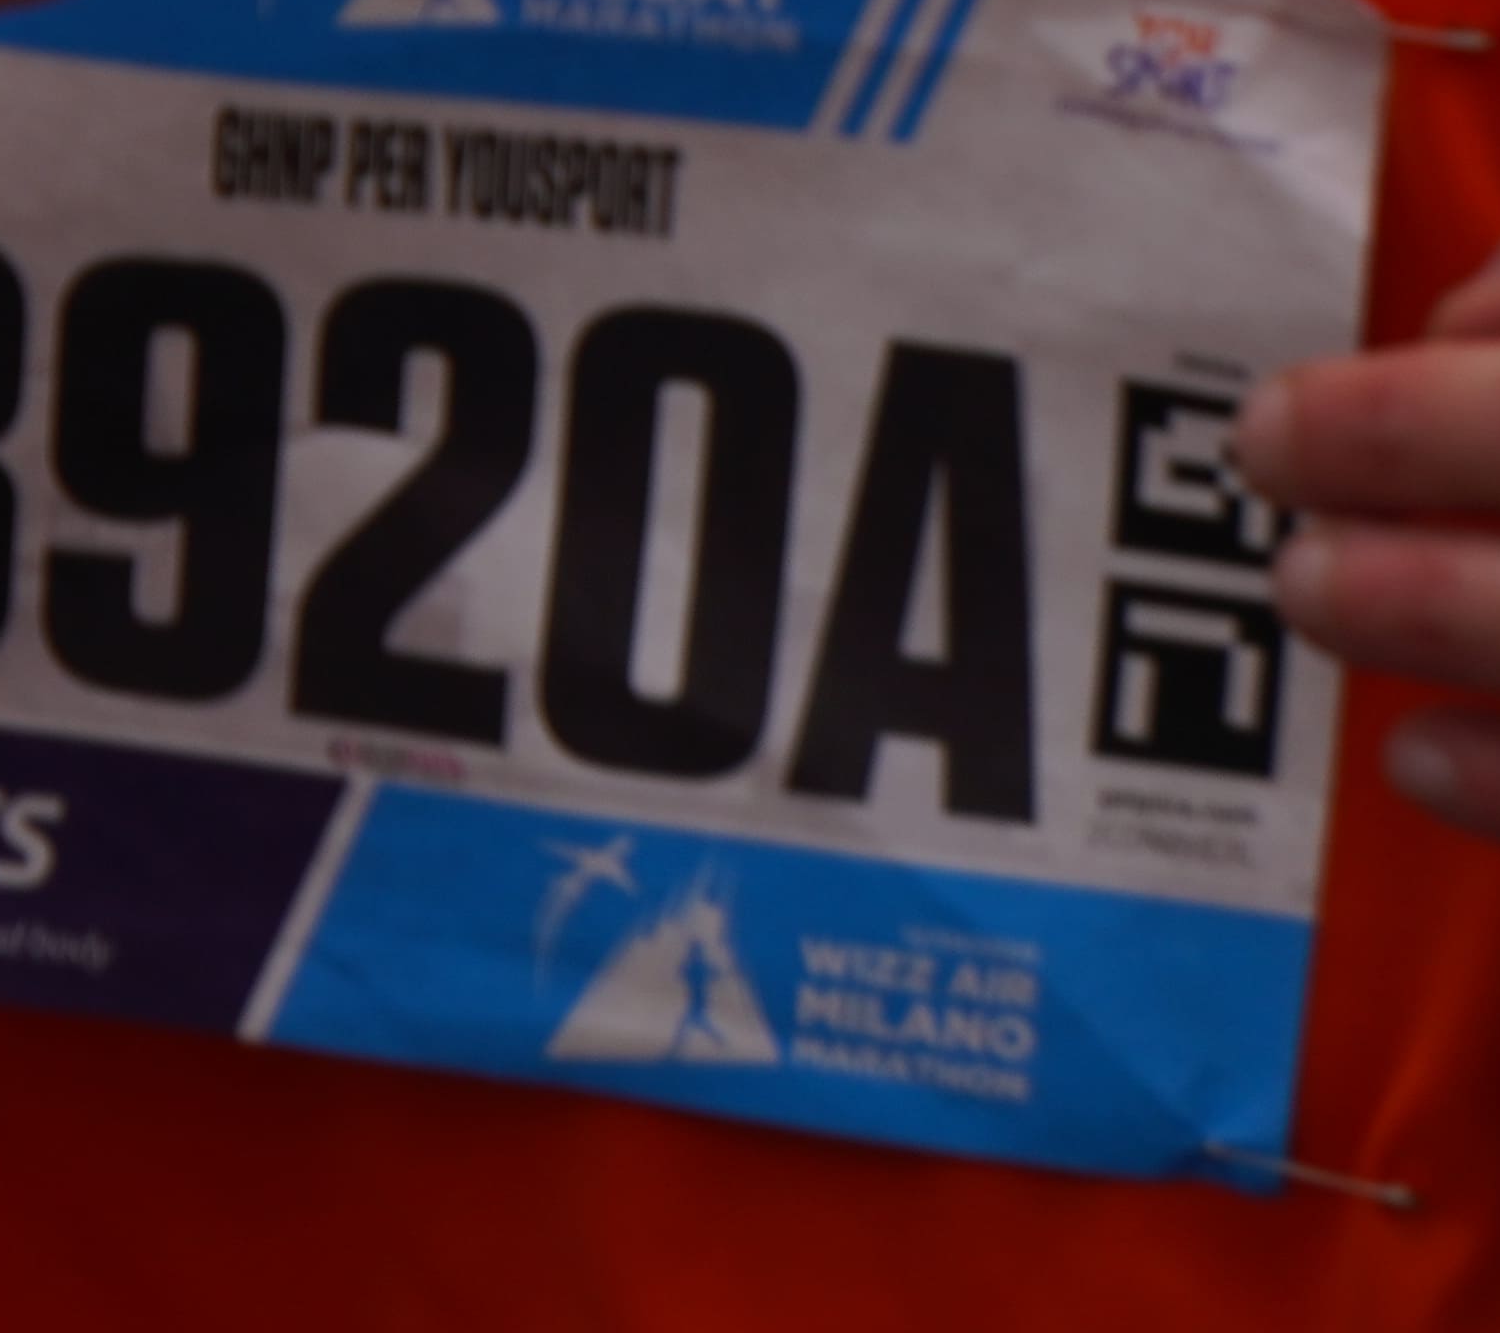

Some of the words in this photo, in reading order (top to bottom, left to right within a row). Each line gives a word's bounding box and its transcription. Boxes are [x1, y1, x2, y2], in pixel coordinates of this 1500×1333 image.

[344, 116, 429, 213] PER
[445, 125, 680, 238] YOUSPORT
[798, 934, 935, 996] WIZZ
[946, 962, 1040, 1010] AIR
[795, 979, 1040, 1063] MILANO
